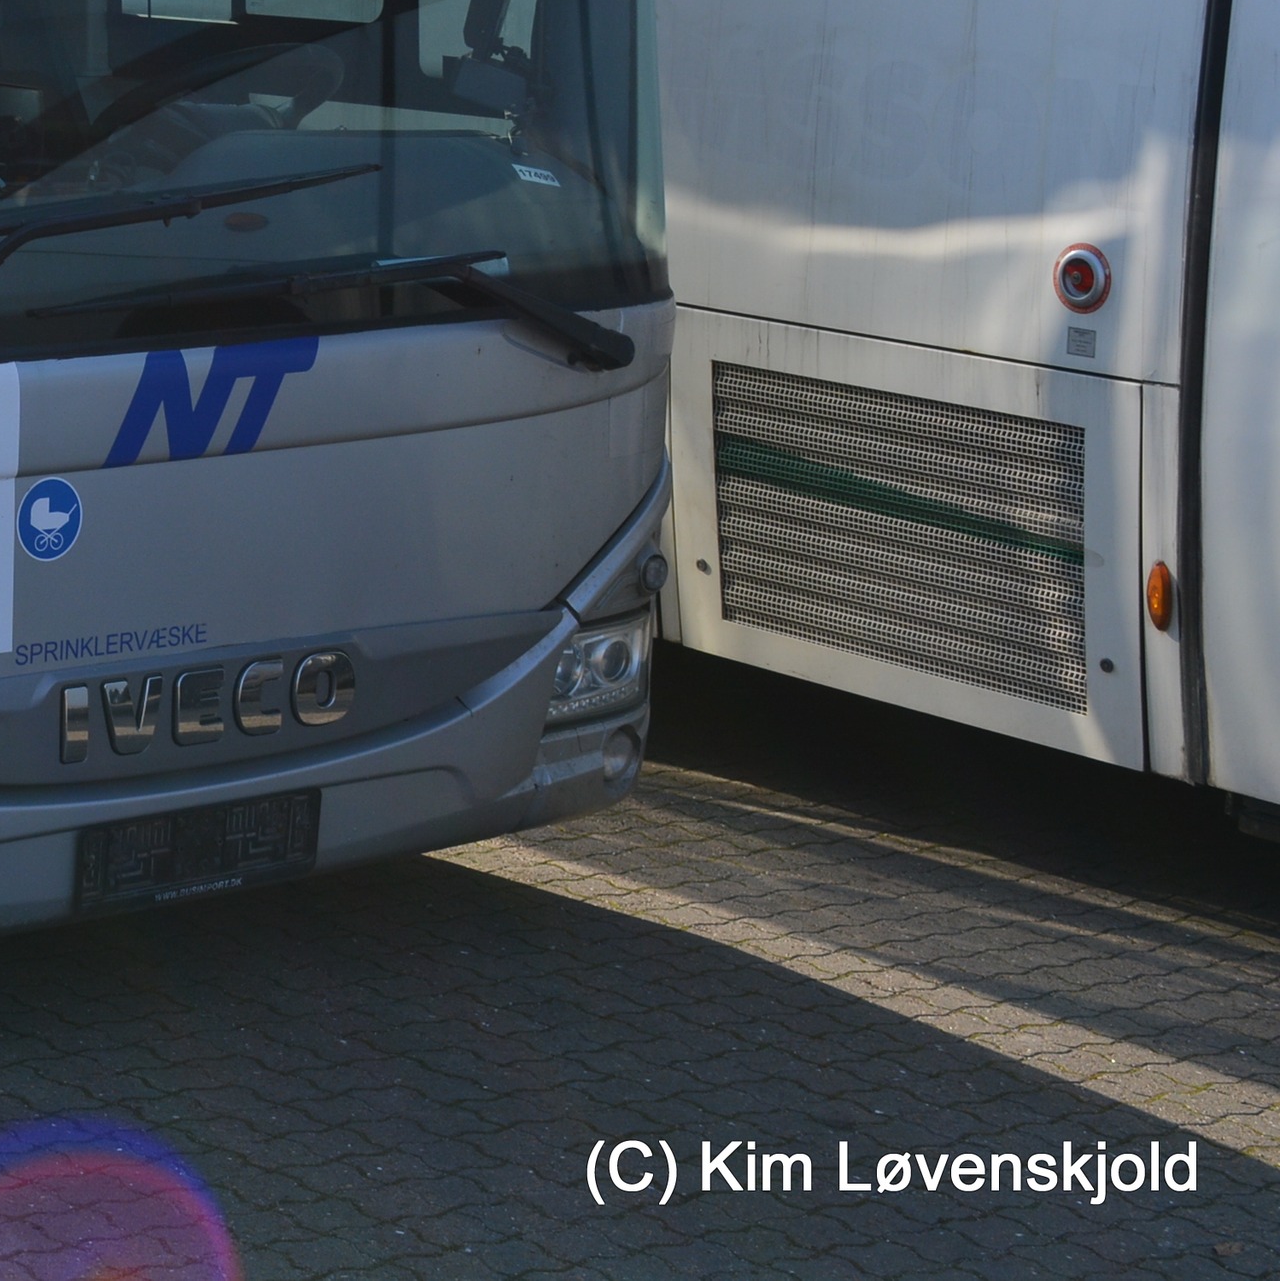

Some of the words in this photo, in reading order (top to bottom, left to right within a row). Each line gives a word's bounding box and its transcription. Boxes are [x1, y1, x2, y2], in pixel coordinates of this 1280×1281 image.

[102, 336, 319, 469] NT
[15, 621, 208, 667] SPRINKLERVÆSKE
[59, 649, 357, 764] IVECO
